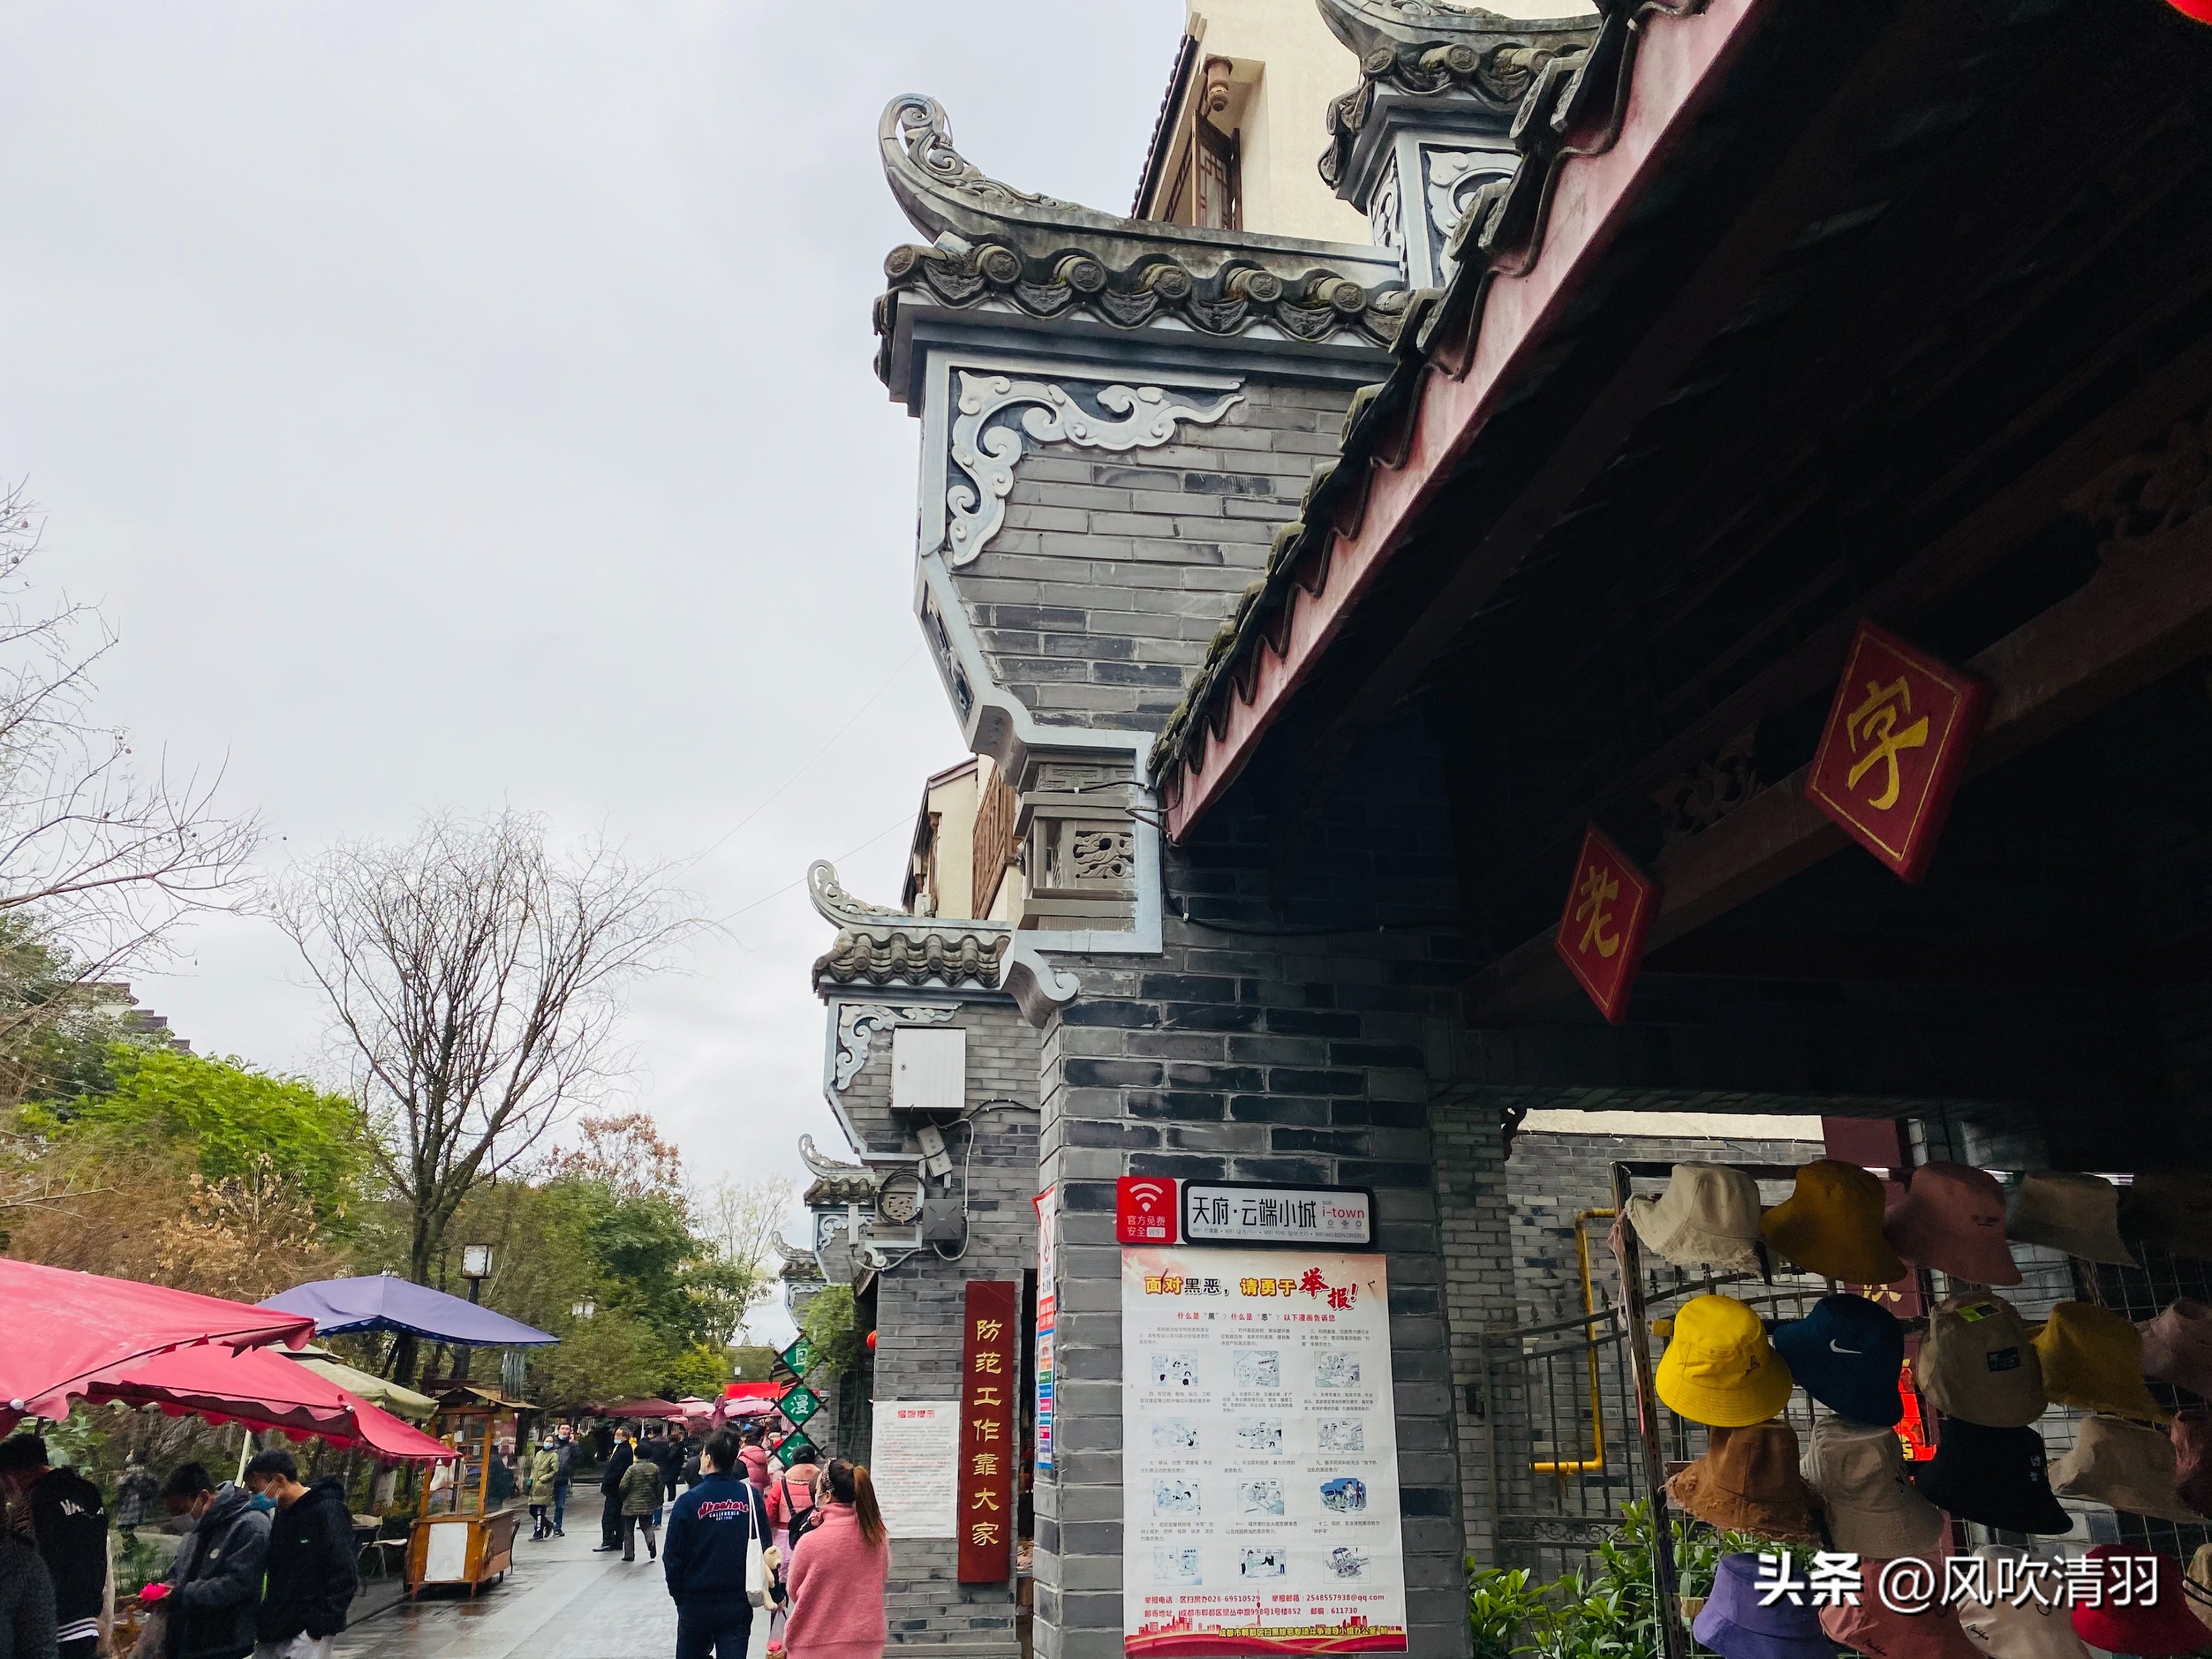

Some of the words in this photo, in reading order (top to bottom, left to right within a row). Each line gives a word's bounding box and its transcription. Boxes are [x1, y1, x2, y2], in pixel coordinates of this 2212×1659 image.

[1846, 675, 1929, 811] 字
[1127, 1215, 1166, 1227] 官方免费
[1322, 1206, 1365, 1219] i-town
[971, 1319, 1002, 1546] 防范工作靠大家
